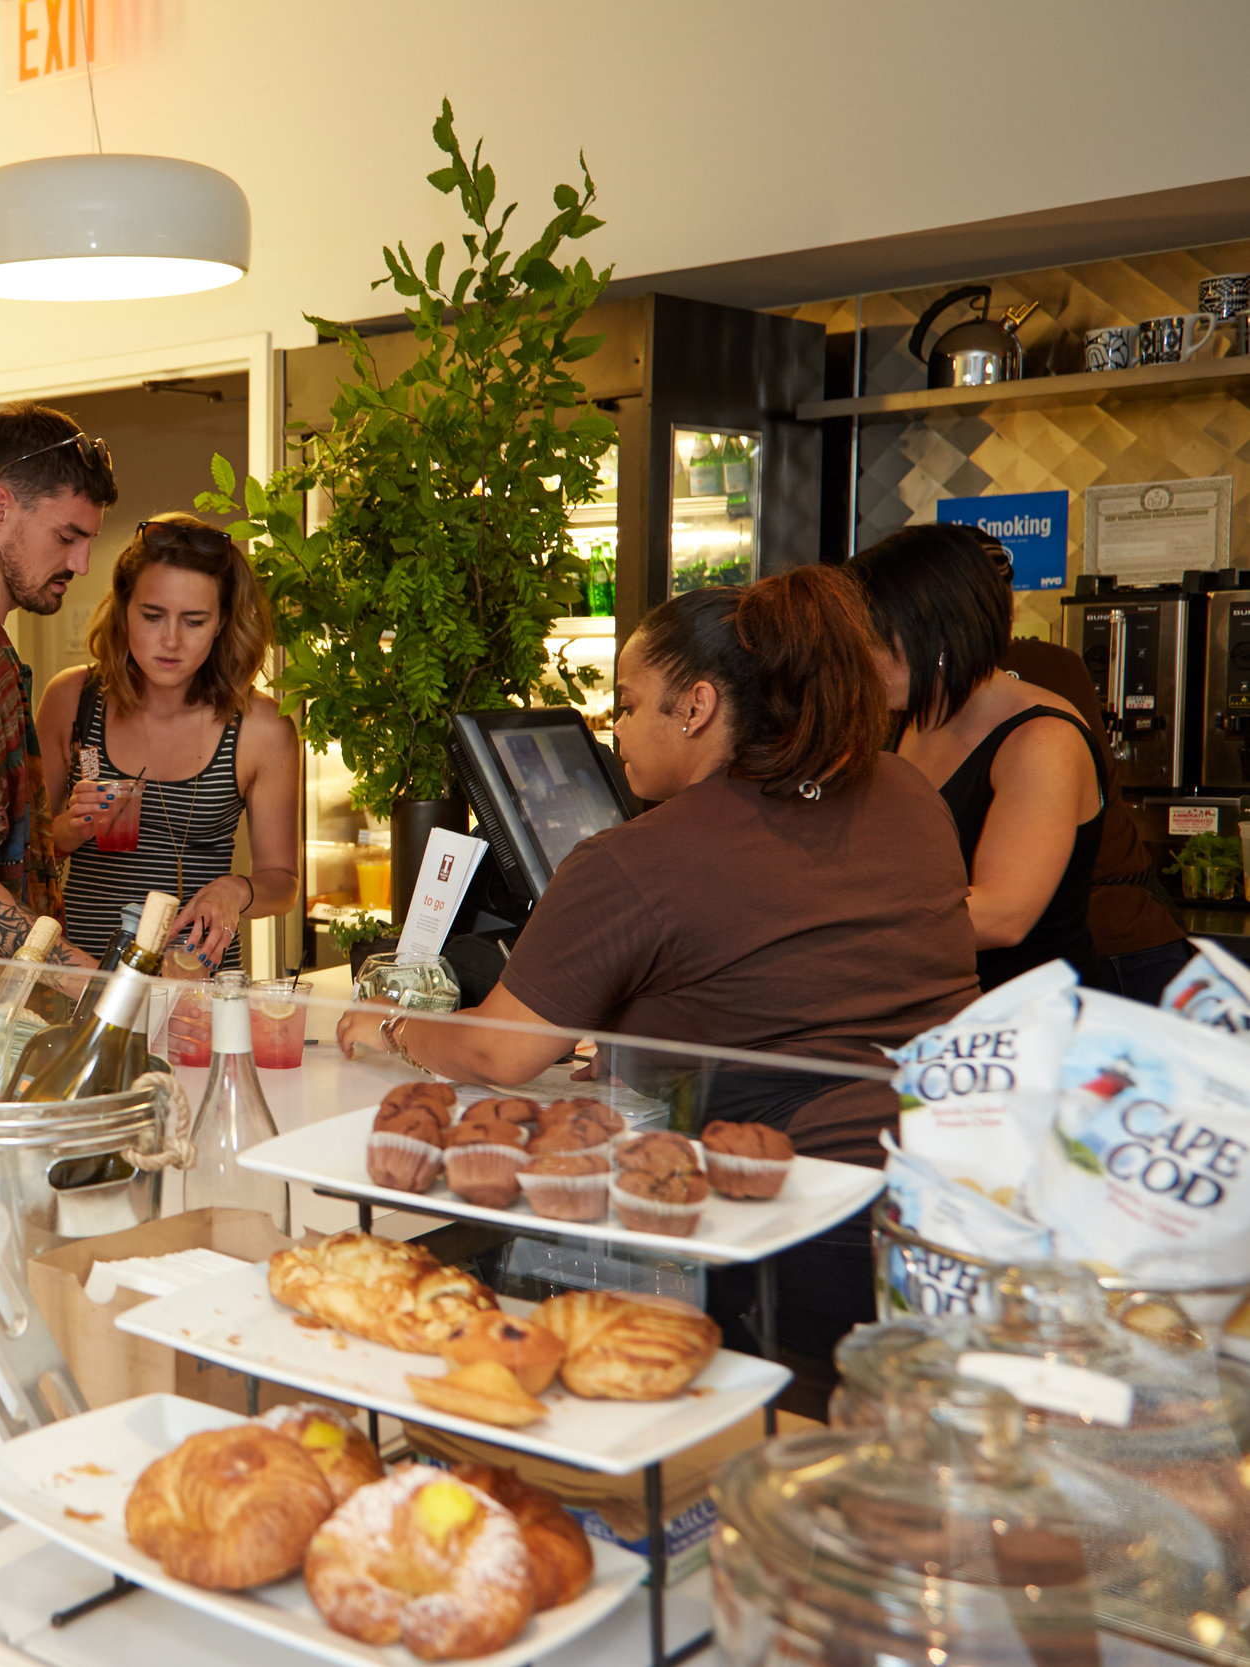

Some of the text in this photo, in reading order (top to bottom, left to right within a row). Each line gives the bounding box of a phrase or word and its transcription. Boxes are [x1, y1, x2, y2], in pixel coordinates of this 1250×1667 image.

[977, 515, 1051, 538] Smoking
[423, 894, 445, 911] to go
[917, 1029, 1017, 1063] CAPE
[917, 1063, 1015, 1101] COD
[1121, 1099, 1248, 1179] CAPE
[1106, 1142, 1226, 1208] COD
